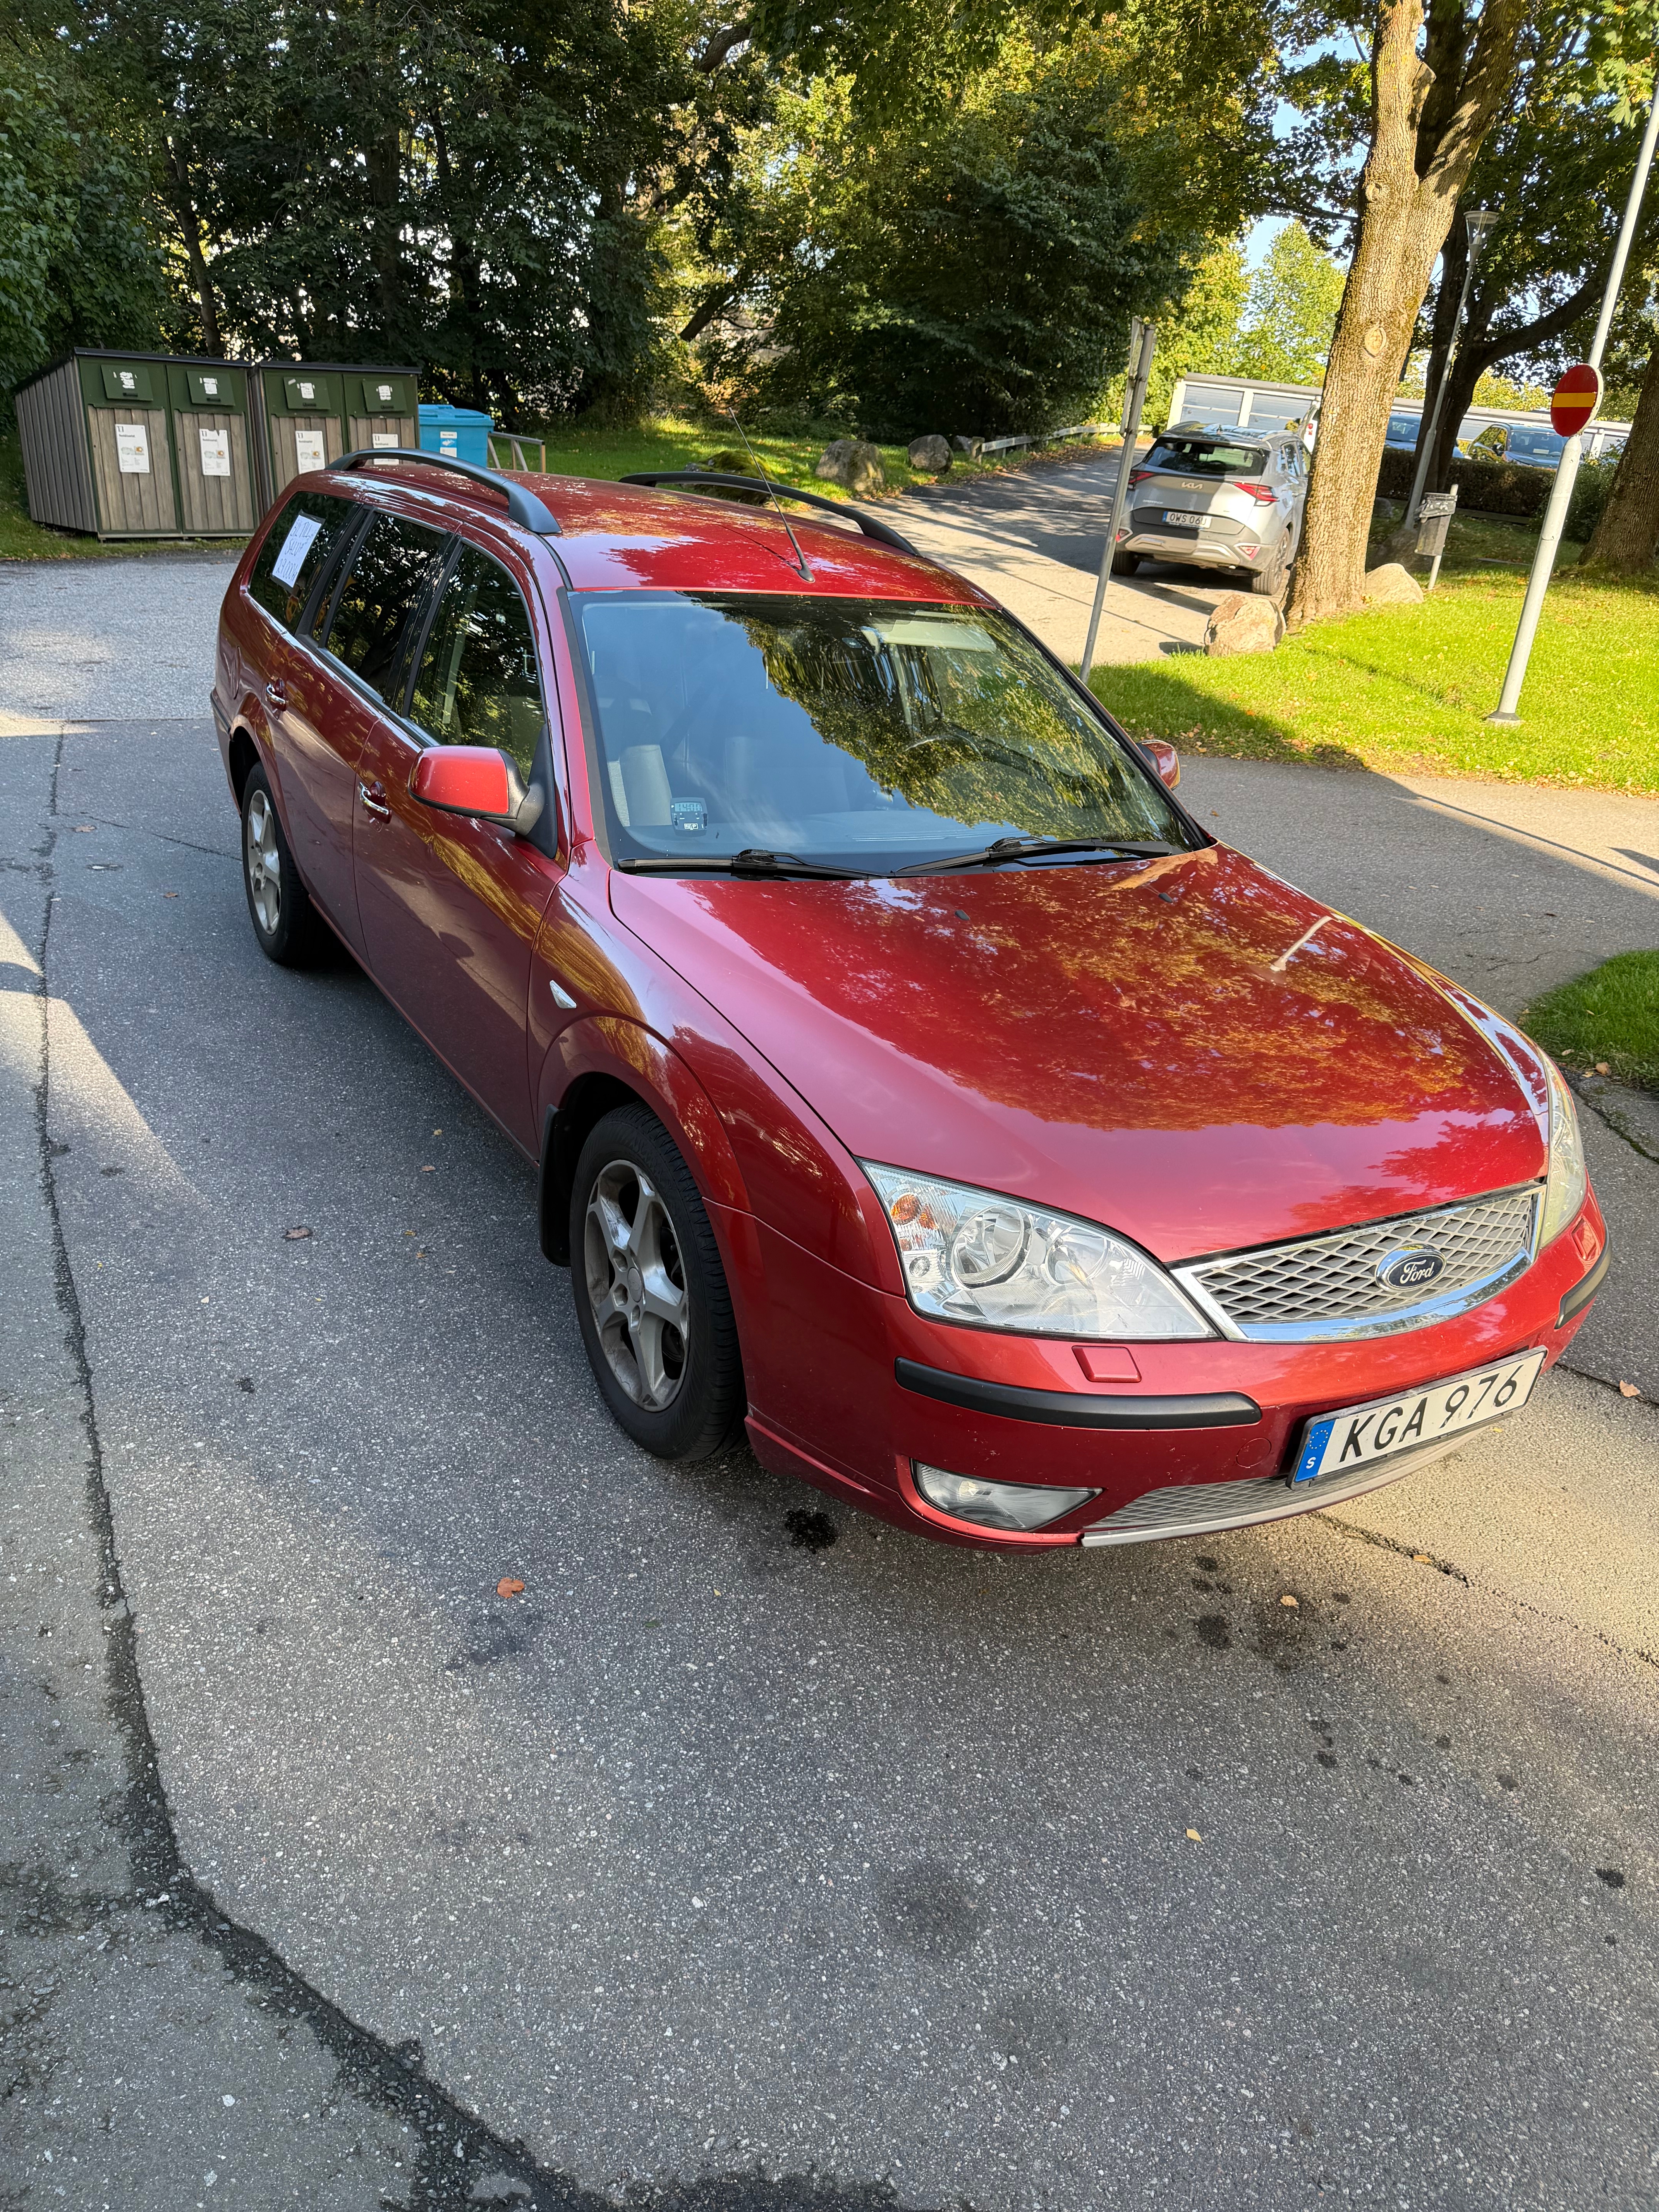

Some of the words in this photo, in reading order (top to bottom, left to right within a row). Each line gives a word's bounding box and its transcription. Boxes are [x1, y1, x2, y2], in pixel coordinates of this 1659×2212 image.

[1170, 513, 1187, 523] OWS
[1400, 1259, 1435, 1284] Ford
[1306, 1456, 1316, 1469] S
[1339, 1397, 1428, 1463] KGA
[1439, 1364, 1524, 1429] 976
